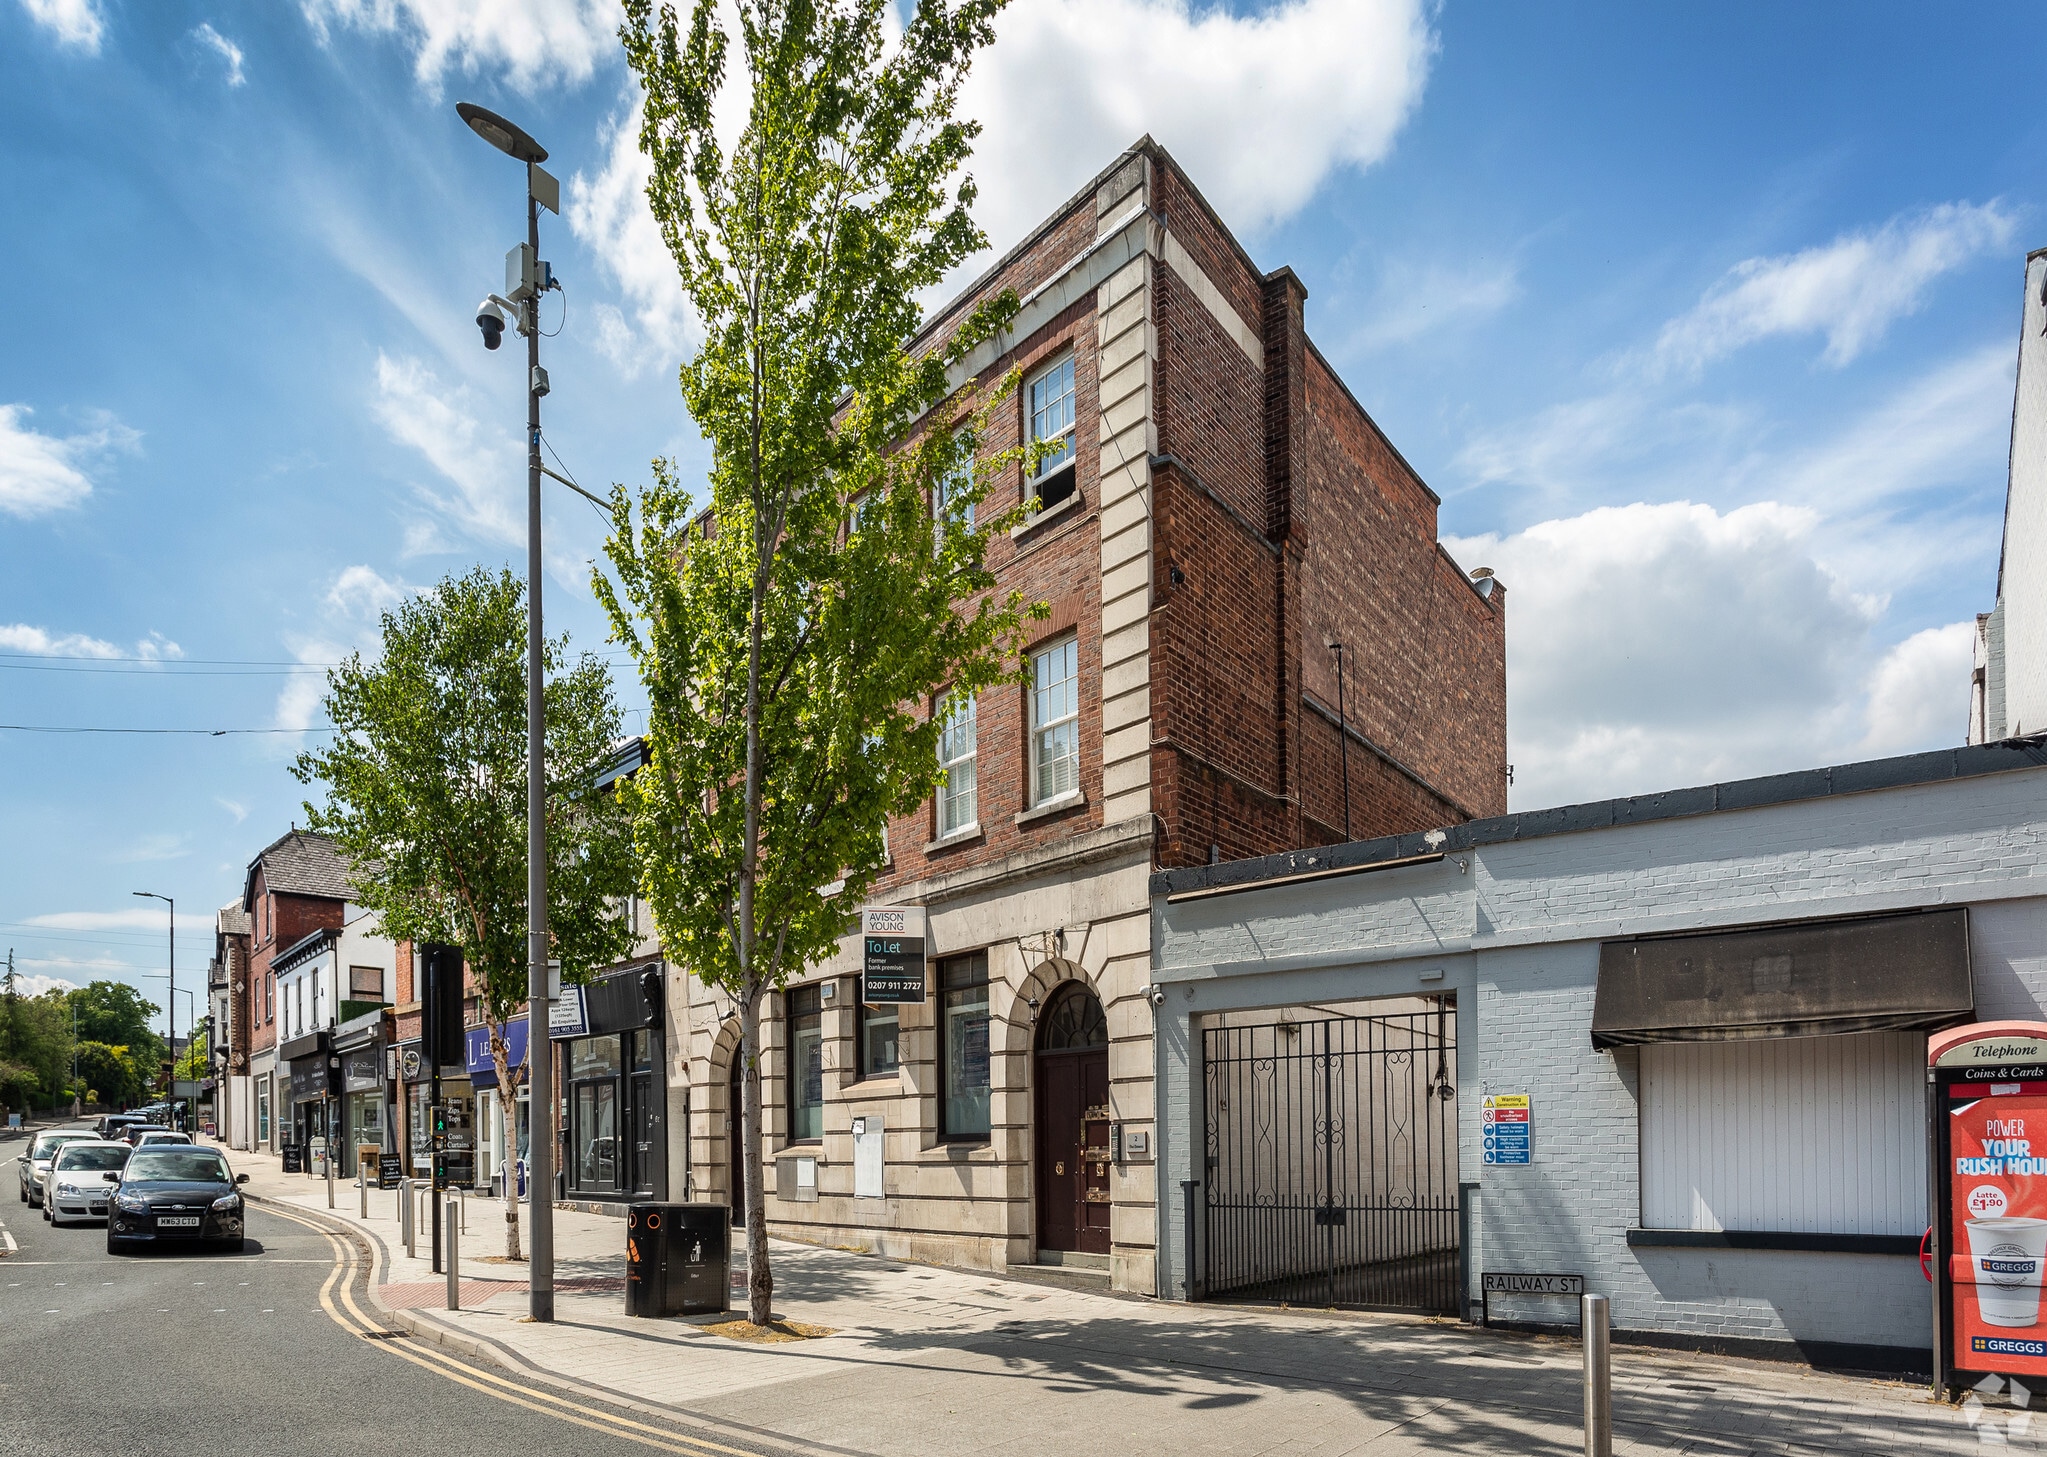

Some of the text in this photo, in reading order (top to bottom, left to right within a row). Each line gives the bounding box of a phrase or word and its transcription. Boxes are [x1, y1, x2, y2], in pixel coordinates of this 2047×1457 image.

[869, 912, 904, 921] AVISON
[869, 921, 904, 931] YOUNG
[867, 940, 901, 953] To Let
[881, 964, 905, 972] premises
[868, 981, 922, 990] 0207 911 2727
[1973, 1044, 2038, 1059] Telephone
[1965, 1066, 2044, 1079] Coins & Cards
[447, 1106, 461, 1114] Zips
[447, 1115, 461, 1123] Tops
[1986, 1119, 2025, 1137] POWER
[447, 1141, 470, 1149] Curtains
[1981, 1138, 2031, 1157] YOUR
[1956, 1157, 2047, 1176] RUSH HOU
[1972, 1199, 2003, 1211] £1.90
[1991, 1262, 2034, 1272] GREGGS
[1486, 1275, 1578, 1291] RAILWAY ST
[1988, 1340, 2044, 1354] GREGGS
